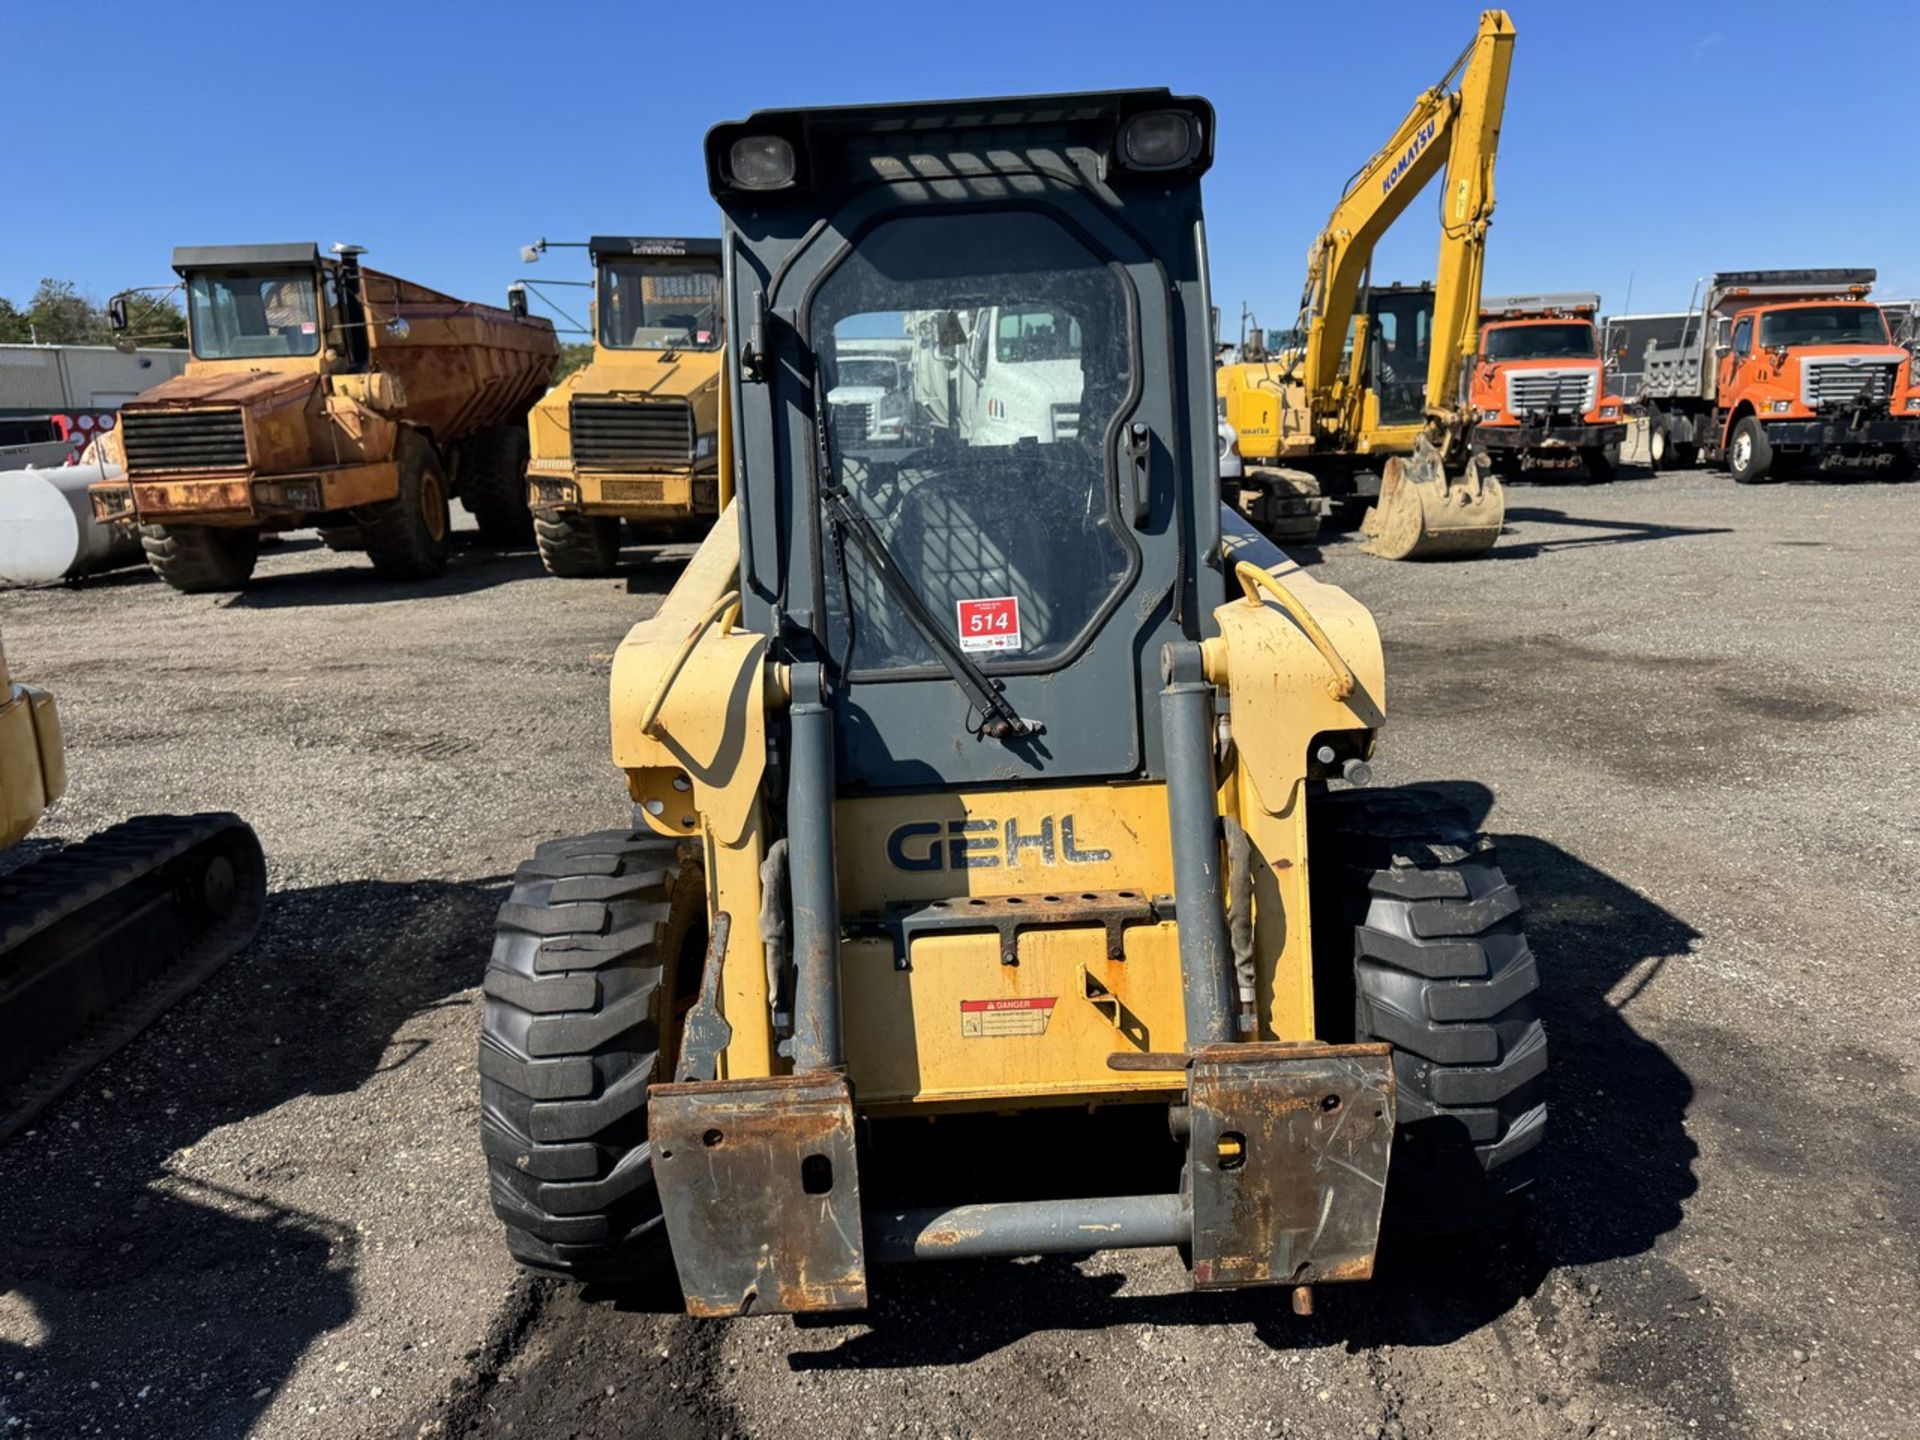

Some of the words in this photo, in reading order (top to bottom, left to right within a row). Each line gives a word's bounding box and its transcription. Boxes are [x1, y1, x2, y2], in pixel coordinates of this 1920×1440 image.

[1382, 119, 1435, 195] KOMATSU
[970, 612, 1009, 632] 514
[887, 814, 1112, 872] GEHL
[995, 1000, 1031, 1009] DANGER
